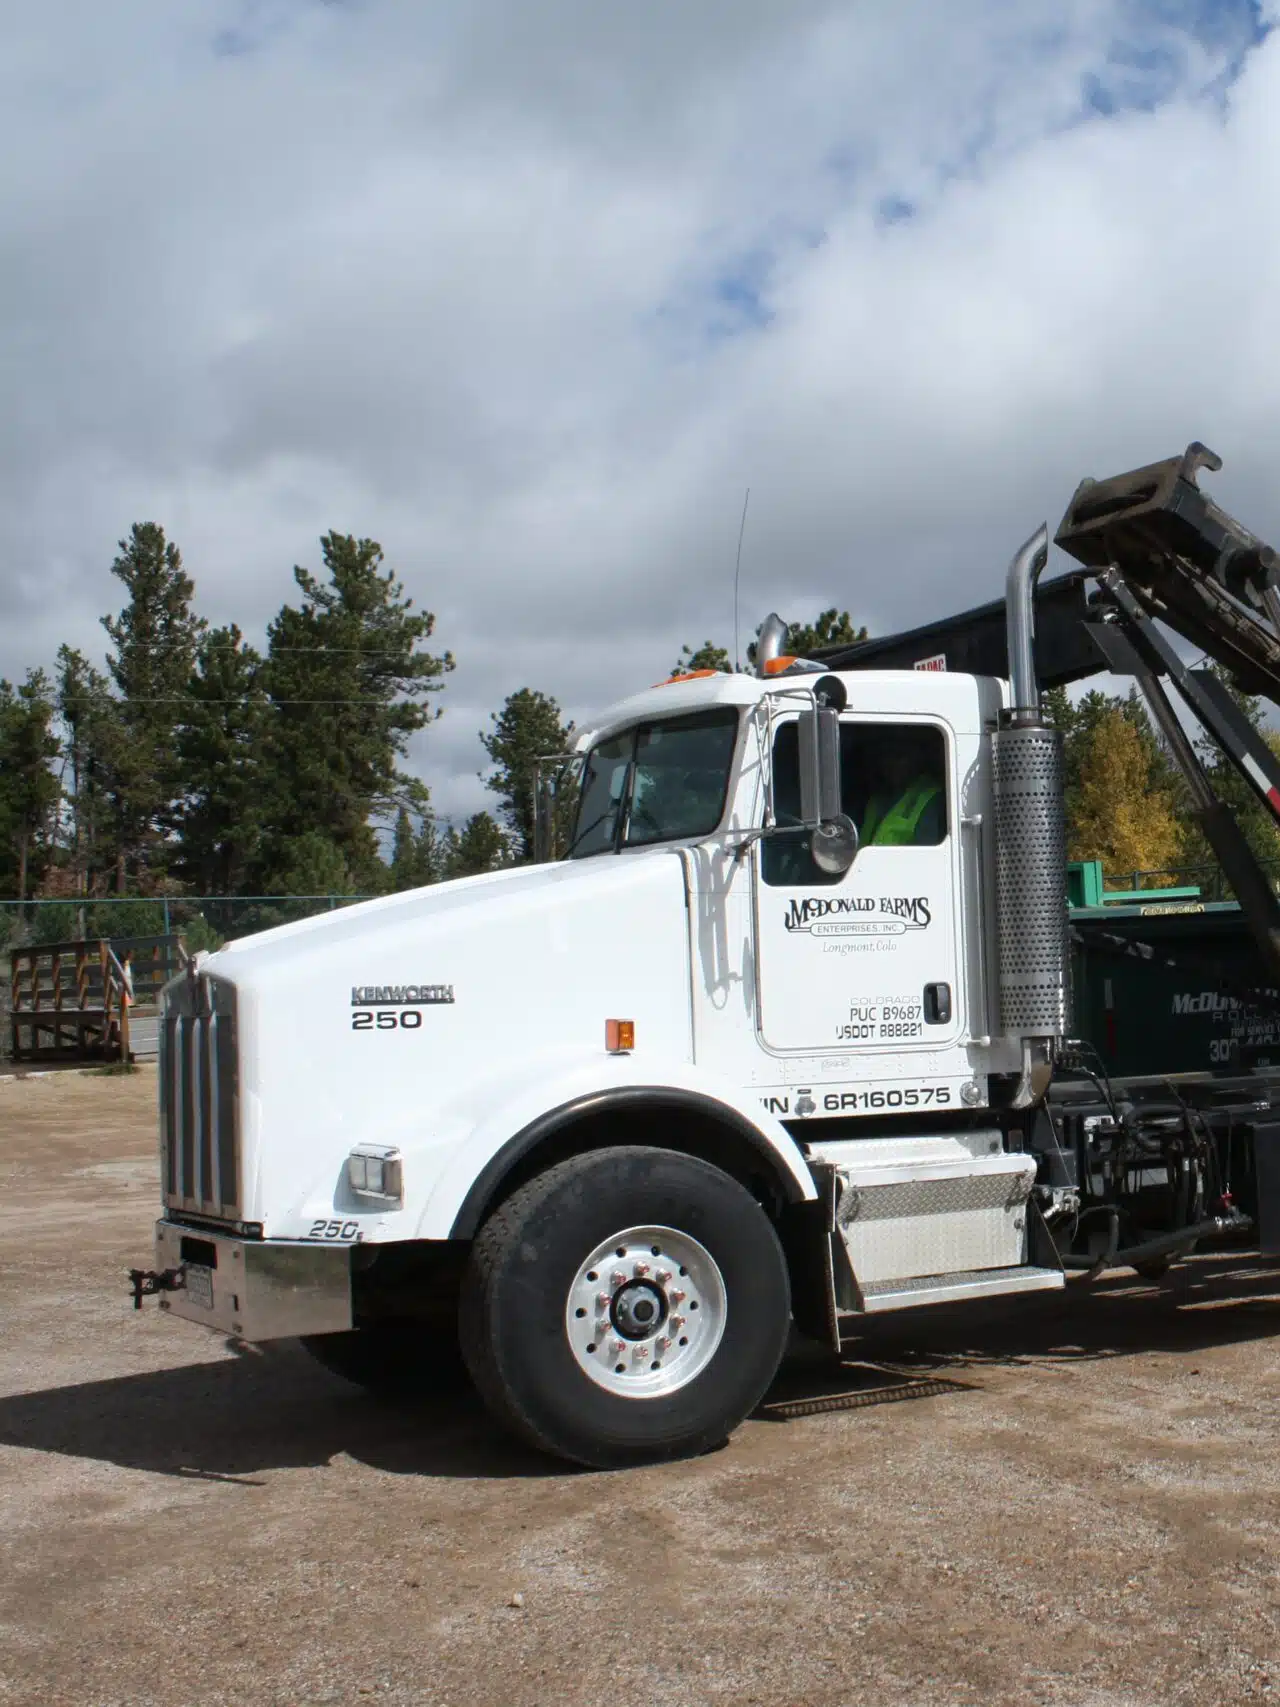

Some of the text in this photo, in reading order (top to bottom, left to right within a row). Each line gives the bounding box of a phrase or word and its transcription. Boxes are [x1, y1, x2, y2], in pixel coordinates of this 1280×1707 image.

[784, 896, 931, 930] McDONALD FARMS
[352, 985, 454, 1002] KENWORTH
[850, 995, 920, 1006] COLORADO
[352, 1010, 422, 1030] 250
[850, 1005, 922, 1022] PUC B9687
[836, 1023, 923, 1039] USDOT 888221
[760, 1087, 951, 1114] IN 6R160575
[308, 1219, 359, 1239] 250
